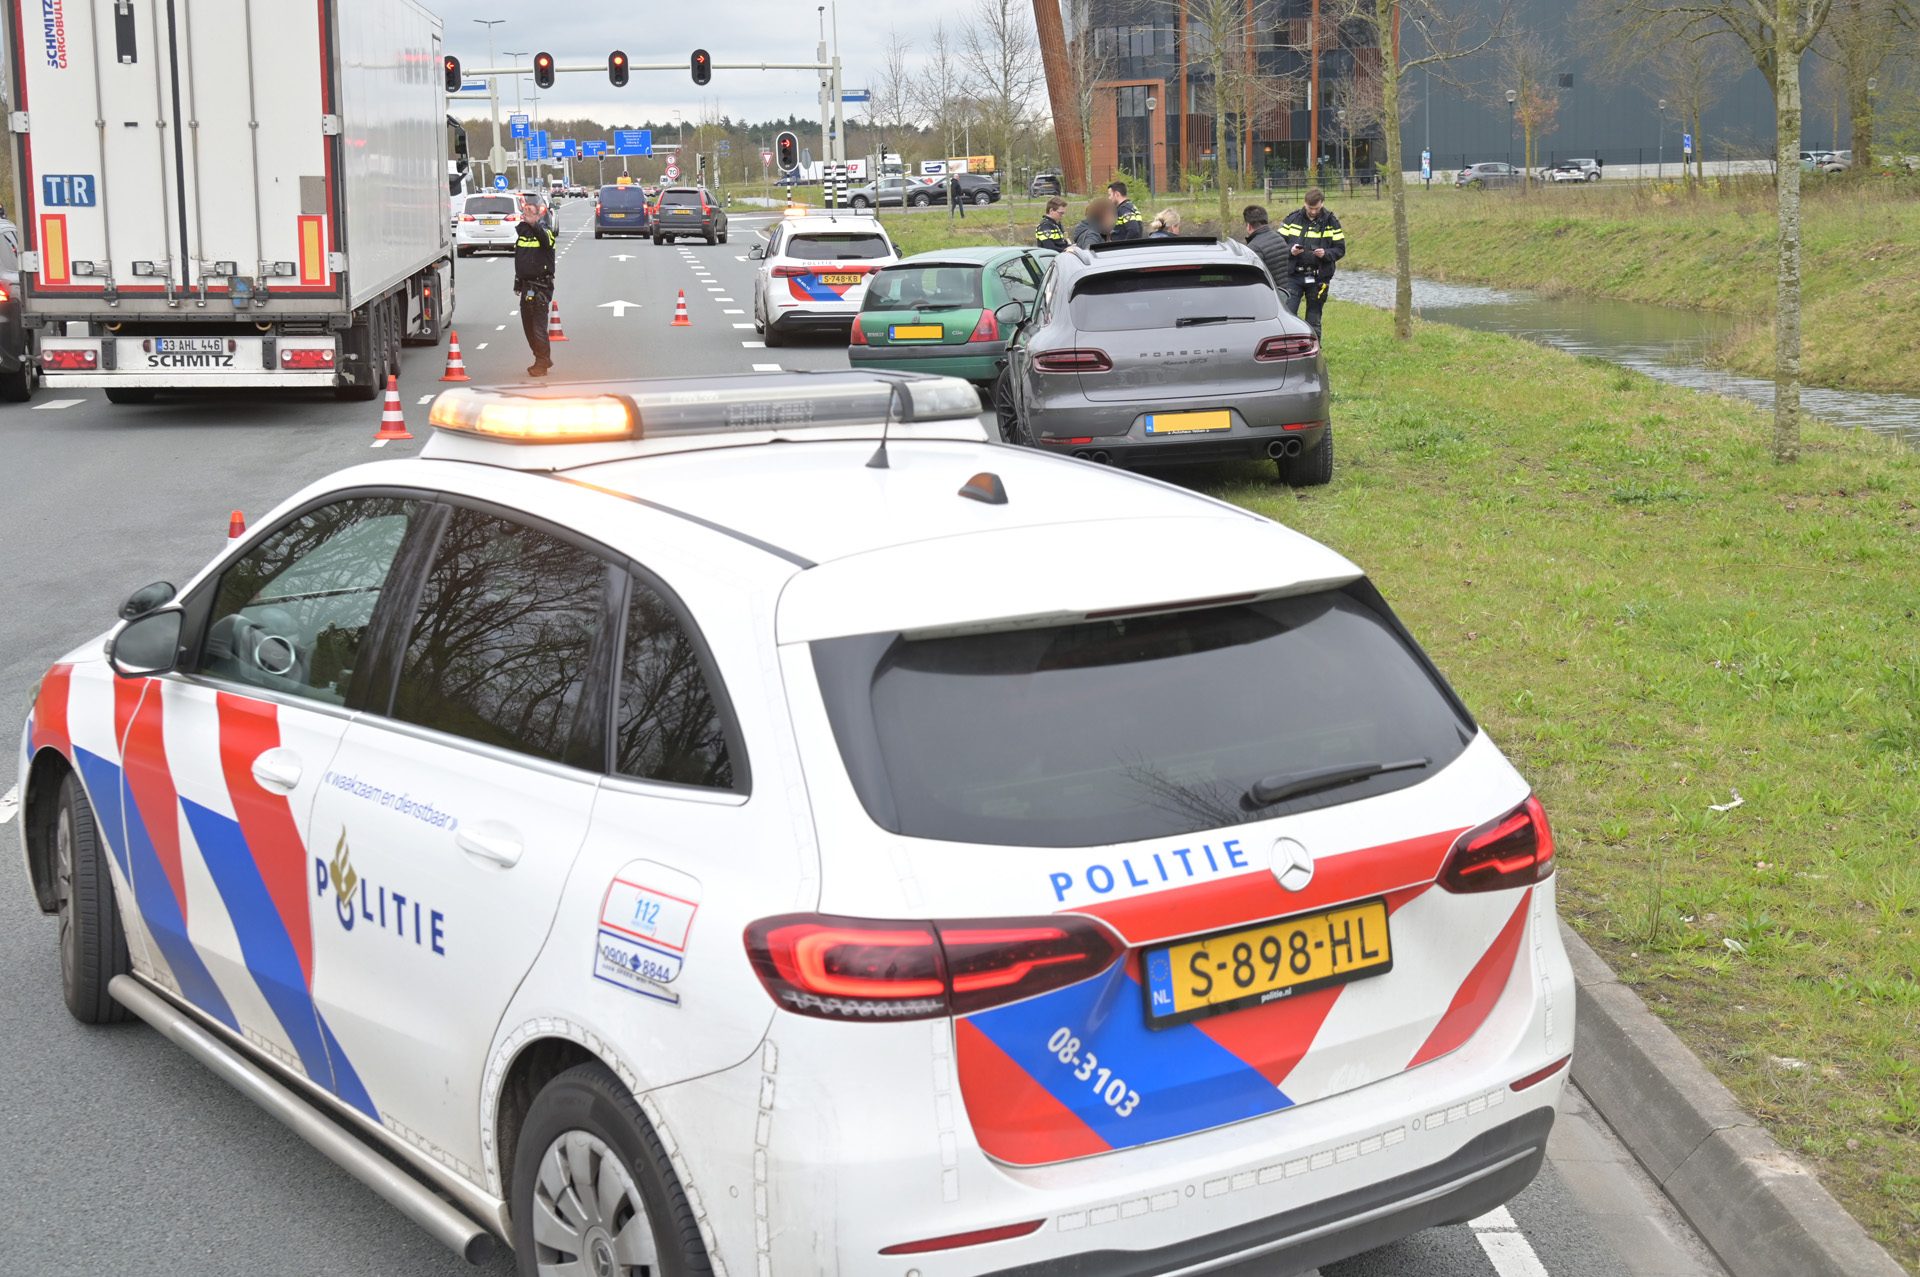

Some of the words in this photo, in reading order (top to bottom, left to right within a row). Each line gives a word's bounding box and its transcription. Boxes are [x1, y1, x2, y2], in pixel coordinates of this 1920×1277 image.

[42, 0, 59, 69] SCHMITZ
[53, 0, 68, 69] CARGOBULL
[46, 177, 89, 204] TIR
[823, 275, 859, 283] S-748-KB
[163, 340, 175, 351] 33
[179, 340, 197, 351] AHL
[201, 339, 220, 351] 446
[1139, 348, 1228, 358] PORSCHE
[147, 354, 234, 368] SCHMITZ
[380, 790, 396, 808] en
[1049, 839, 1248, 902] POLITIE
[315, 857, 446, 956] POLITIE
[634, 898, 660, 925] 112
[1189, 916, 1379, 997] S-898-HL
[642, 959, 670, 981] 8844
[1153, 989, 1172, 1005] NL
[1260, 986, 1293, 1003] politie.nl
[1047, 1026, 1141, 1118] 08-3103
